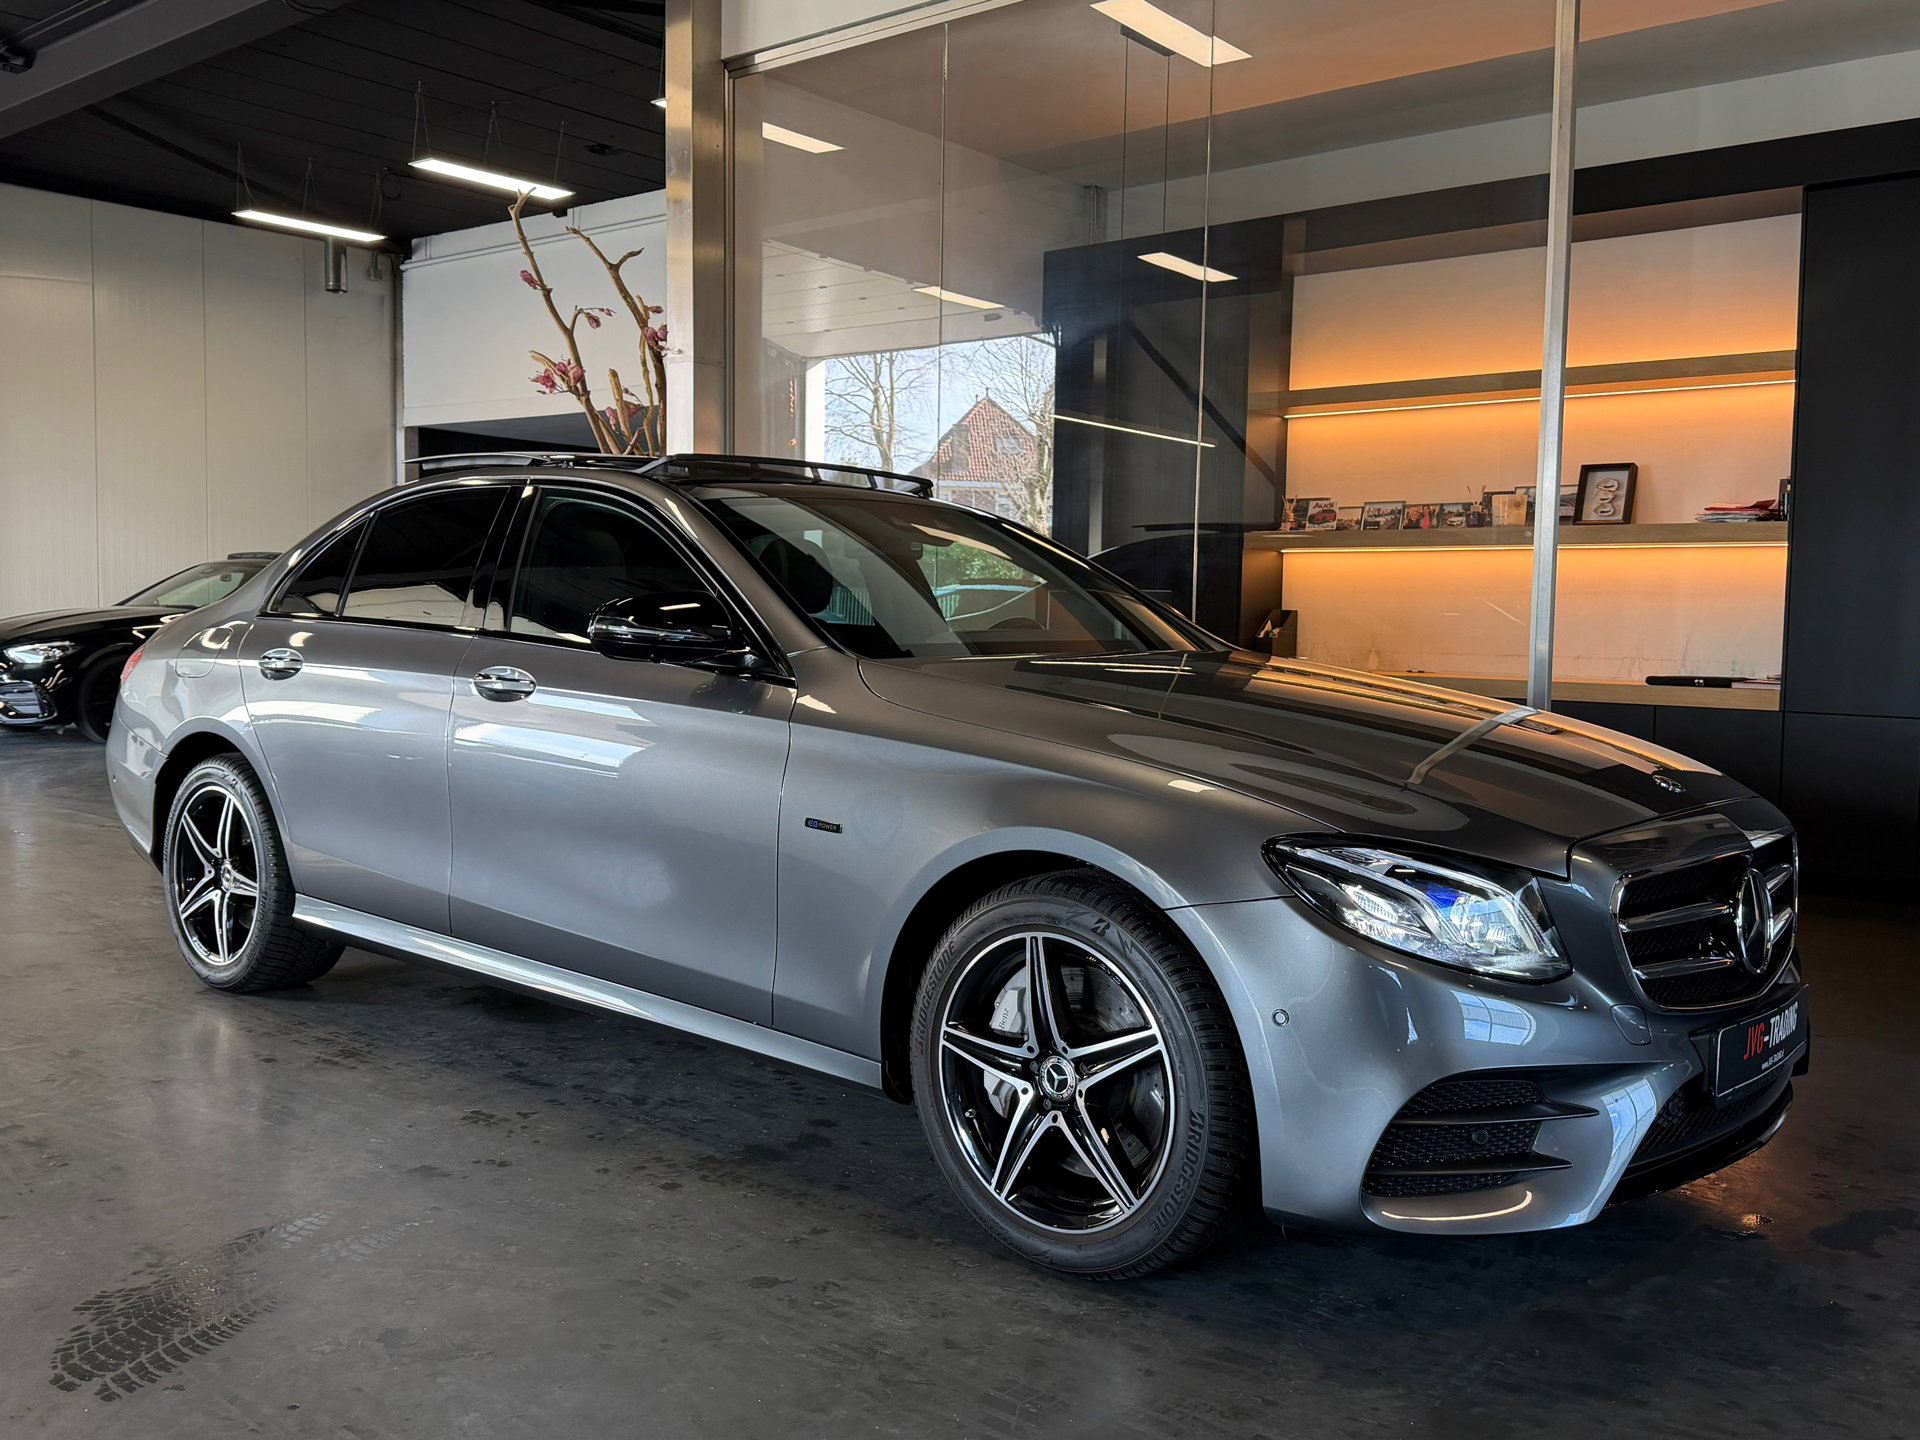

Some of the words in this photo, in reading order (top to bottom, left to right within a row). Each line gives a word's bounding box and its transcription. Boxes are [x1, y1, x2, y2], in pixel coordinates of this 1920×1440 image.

[808, 820, 818, 828] EQ
[914, 940, 956, 1056] BRIDGESTONE
[998, 1008, 1009, 1030] Benz
[1151, 1109, 1206, 1236] BRIDGESTONE
